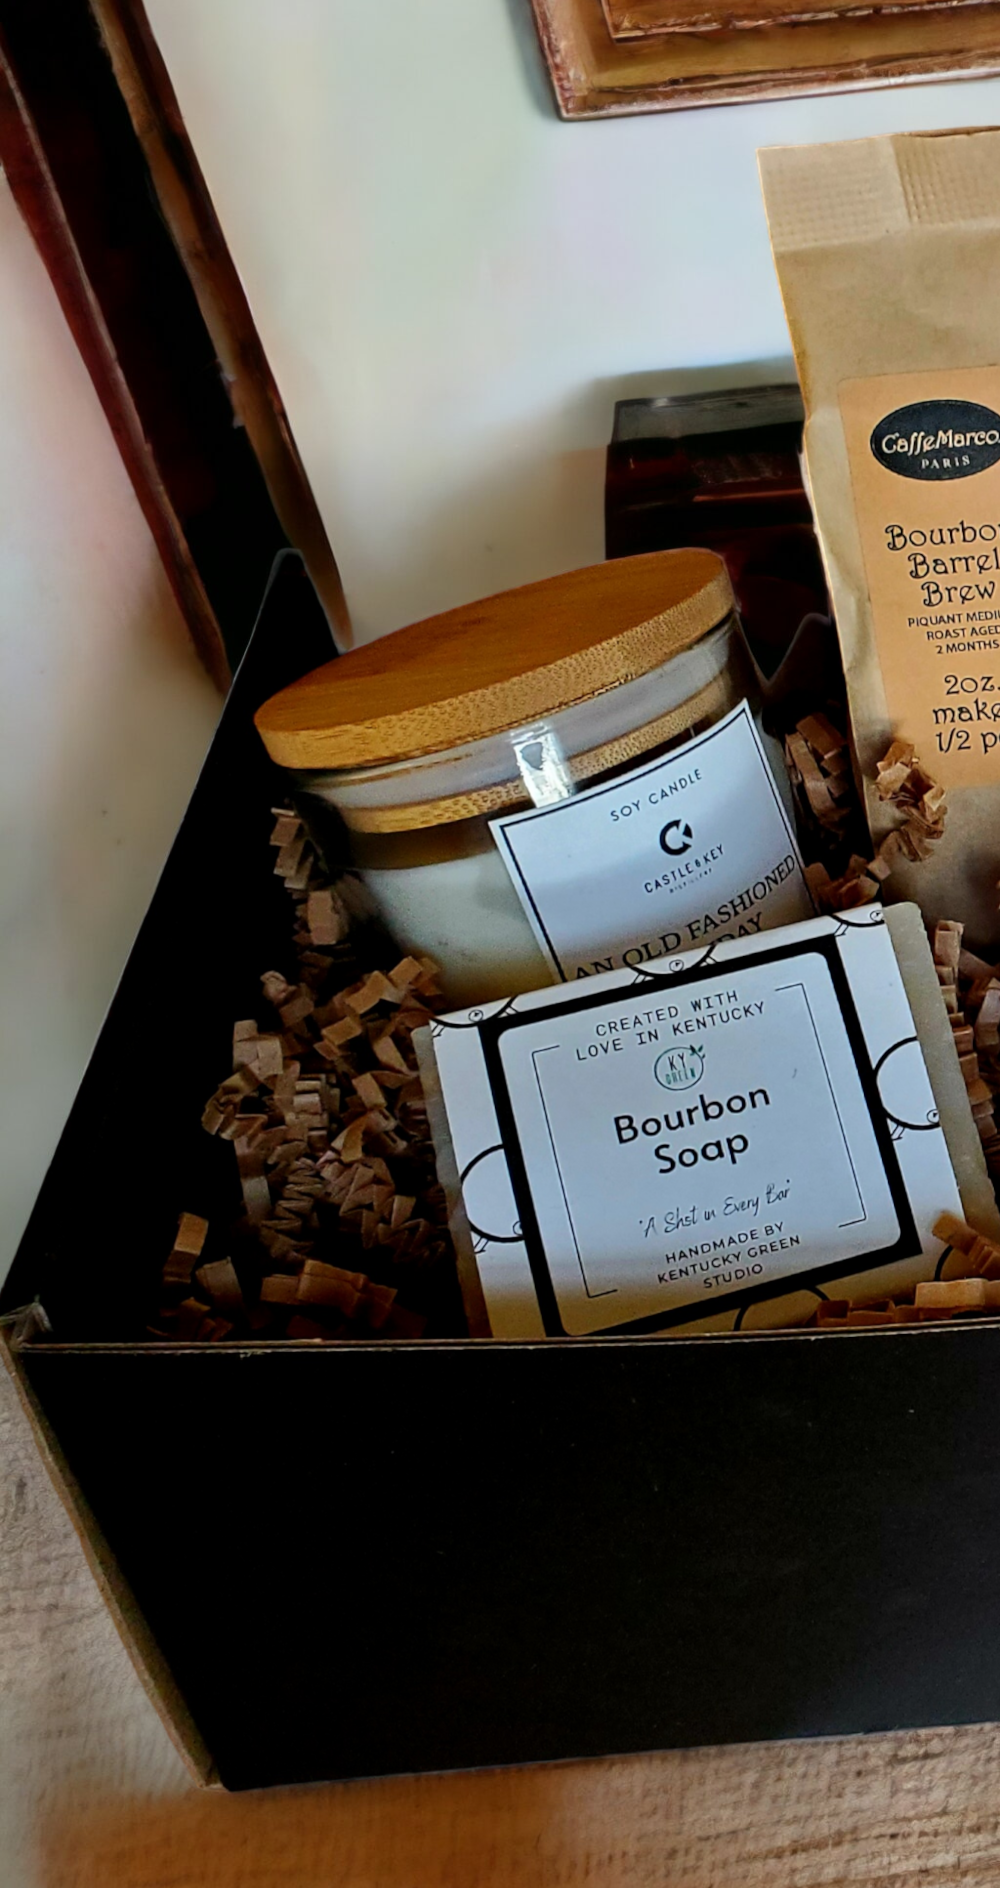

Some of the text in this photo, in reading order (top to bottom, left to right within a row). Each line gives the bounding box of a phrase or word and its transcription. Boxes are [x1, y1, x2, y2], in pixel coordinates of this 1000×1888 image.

[921, 455, 971, 469] PARIS
[920, 580, 997, 607] Brew
[907, 611, 964, 628] PIQUANT
[926, 626, 967, 641] ROAST
[935, 639, 1000, 655] 2 MONTHS
[935, 728, 972, 753] 1/2
[610, 768, 702, 822] SOY CANDLE
[644, 864, 693, 894] CASTLE
[702, 843, 725, 865] KEY
[622, 933, 682, 969] OLD
[686, 854, 796, 941] FASHIONED
[576, 1001, 765, 1061] LOVE IN KENTUCKY
[596, 990, 738, 1037] CREATED WITH
[613, 1087, 771, 1144] Bourbon
[653, 1132, 749, 1175] Soap
[723, 1196, 759, 1217] Every
[657, 1235, 800, 1284] KENTUCKY GREEN
[665, 1221, 784, 1264] HANDMADE BY
[703, 1263, 763, 1289] STUDIO
